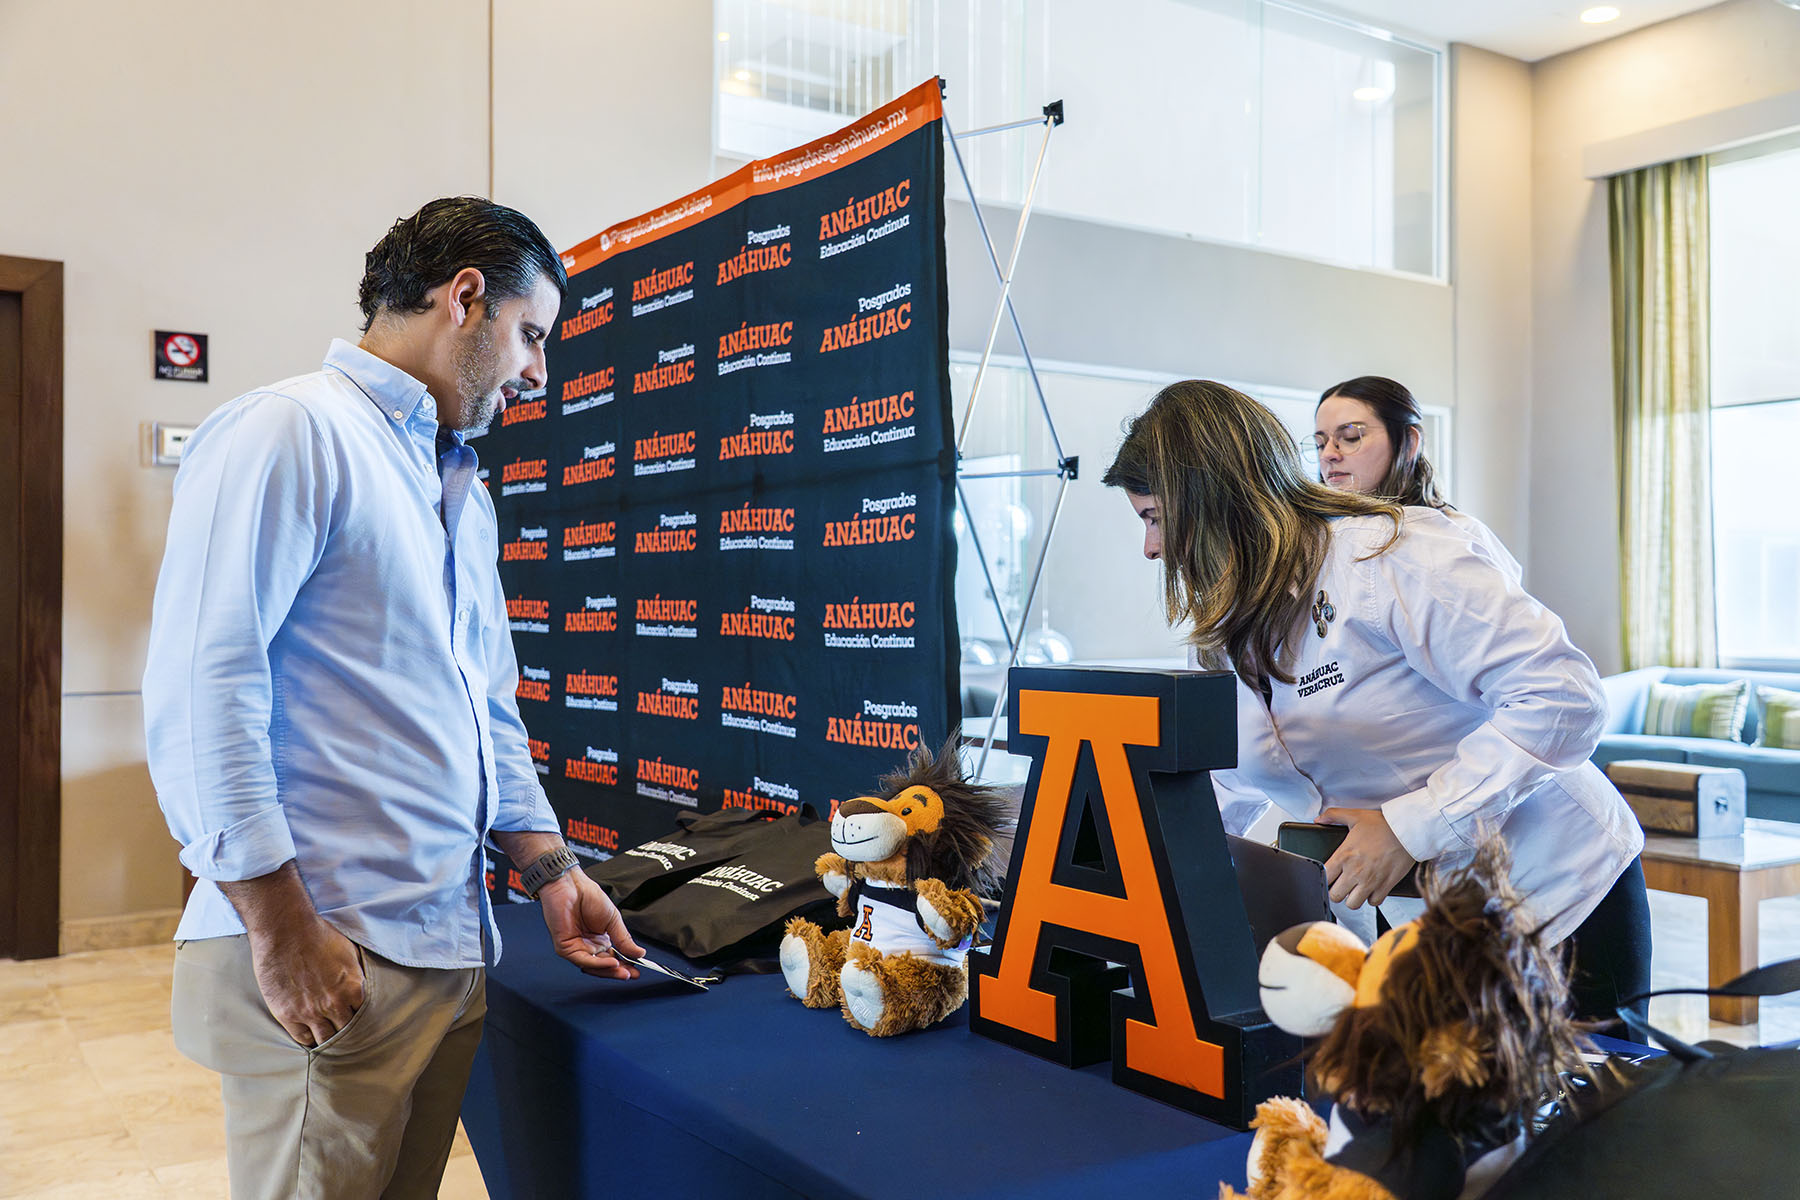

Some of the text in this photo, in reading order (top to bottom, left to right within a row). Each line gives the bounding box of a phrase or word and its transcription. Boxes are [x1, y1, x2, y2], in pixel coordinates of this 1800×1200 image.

[819, 178, 910, 241] ANÁHUAC
[747, 224, 791, 246] Posgrados
[820, 215, 910, 260] Educación Continua
[717, 242, 792, 286] ANÁHUAC
[632, 261, 694, 302] ANÁHUAC
[857, 283, 912, 313] Posgrados
[561, 301, 614, 341] ANÁHUAC
[819, 302, 912, 353] ANÁHUAC
[717, 321, 793, 359] ANÁHUAC
[633, 359, 695, 394] ANÁHUAC
[717, 351, 792, 376] Educación Continua
[562, 366, 615, 401] ANÁHUAC
[750, 410, 795, 430] Posgrados
[822, 390, 915, 434] ANÁHUAC
[634, 430, 696, 461] ANÁHUAC
[719, 426, 795, 461] ANÁHUAC
[823, 425, 916, 453] Educación Continua
[502, 457, 547, 483] ANÁHUAC
[562, 457, 616, 486] ANÁHUAC
[720, 501, 795, 534] ANÁHUAC
[861, 491, 917, 515] Posgrados
[563, 520, 616, 547] ANÁHUAC
[634, 525, 697, 553] ANÁHUAC
[720, 536, 794, 551] Educación Continua
[823, 512, 916, 547] ANÁHUAC
[503, 537, 548, 562] ANÁHUAC
[564, 607, 617, 632] ANÁHUAC
[636, 593, 697, 622] ANÁHUAC
[751, 594, 796, 614] Posgrados
[823, 595, 915, 629] ANÁHUAC
[719, 606, 795, 641] ANÁHUAC
[824, 633, 915, 649] Educación Continua
[515, 675, 551, 702] ÁHUAC
[565, 669, 618, 696] ANÁHUAC
[1297, 672, 1345, 698] VERACRUZ
[636, 687, 699, 720] ANÁHUAC
[721, 681, 797, 720] ANÁHUAC
[863, 699, 918, 720] Posgrados
[721, 713, 797, 739] Educación Continua
[825, 712, 919, 751] ANÁHUAC
[565, 755, 618, 786] ANÁHUAC
[636, 756, 699, 791] ANÁHUAC
[753, 776, 800, 801] Posgrados
[567, 817, 619, 850] ANÁHUAC
[979, 688, 1226, 1101] A
[852, 904, 875, 942] A
